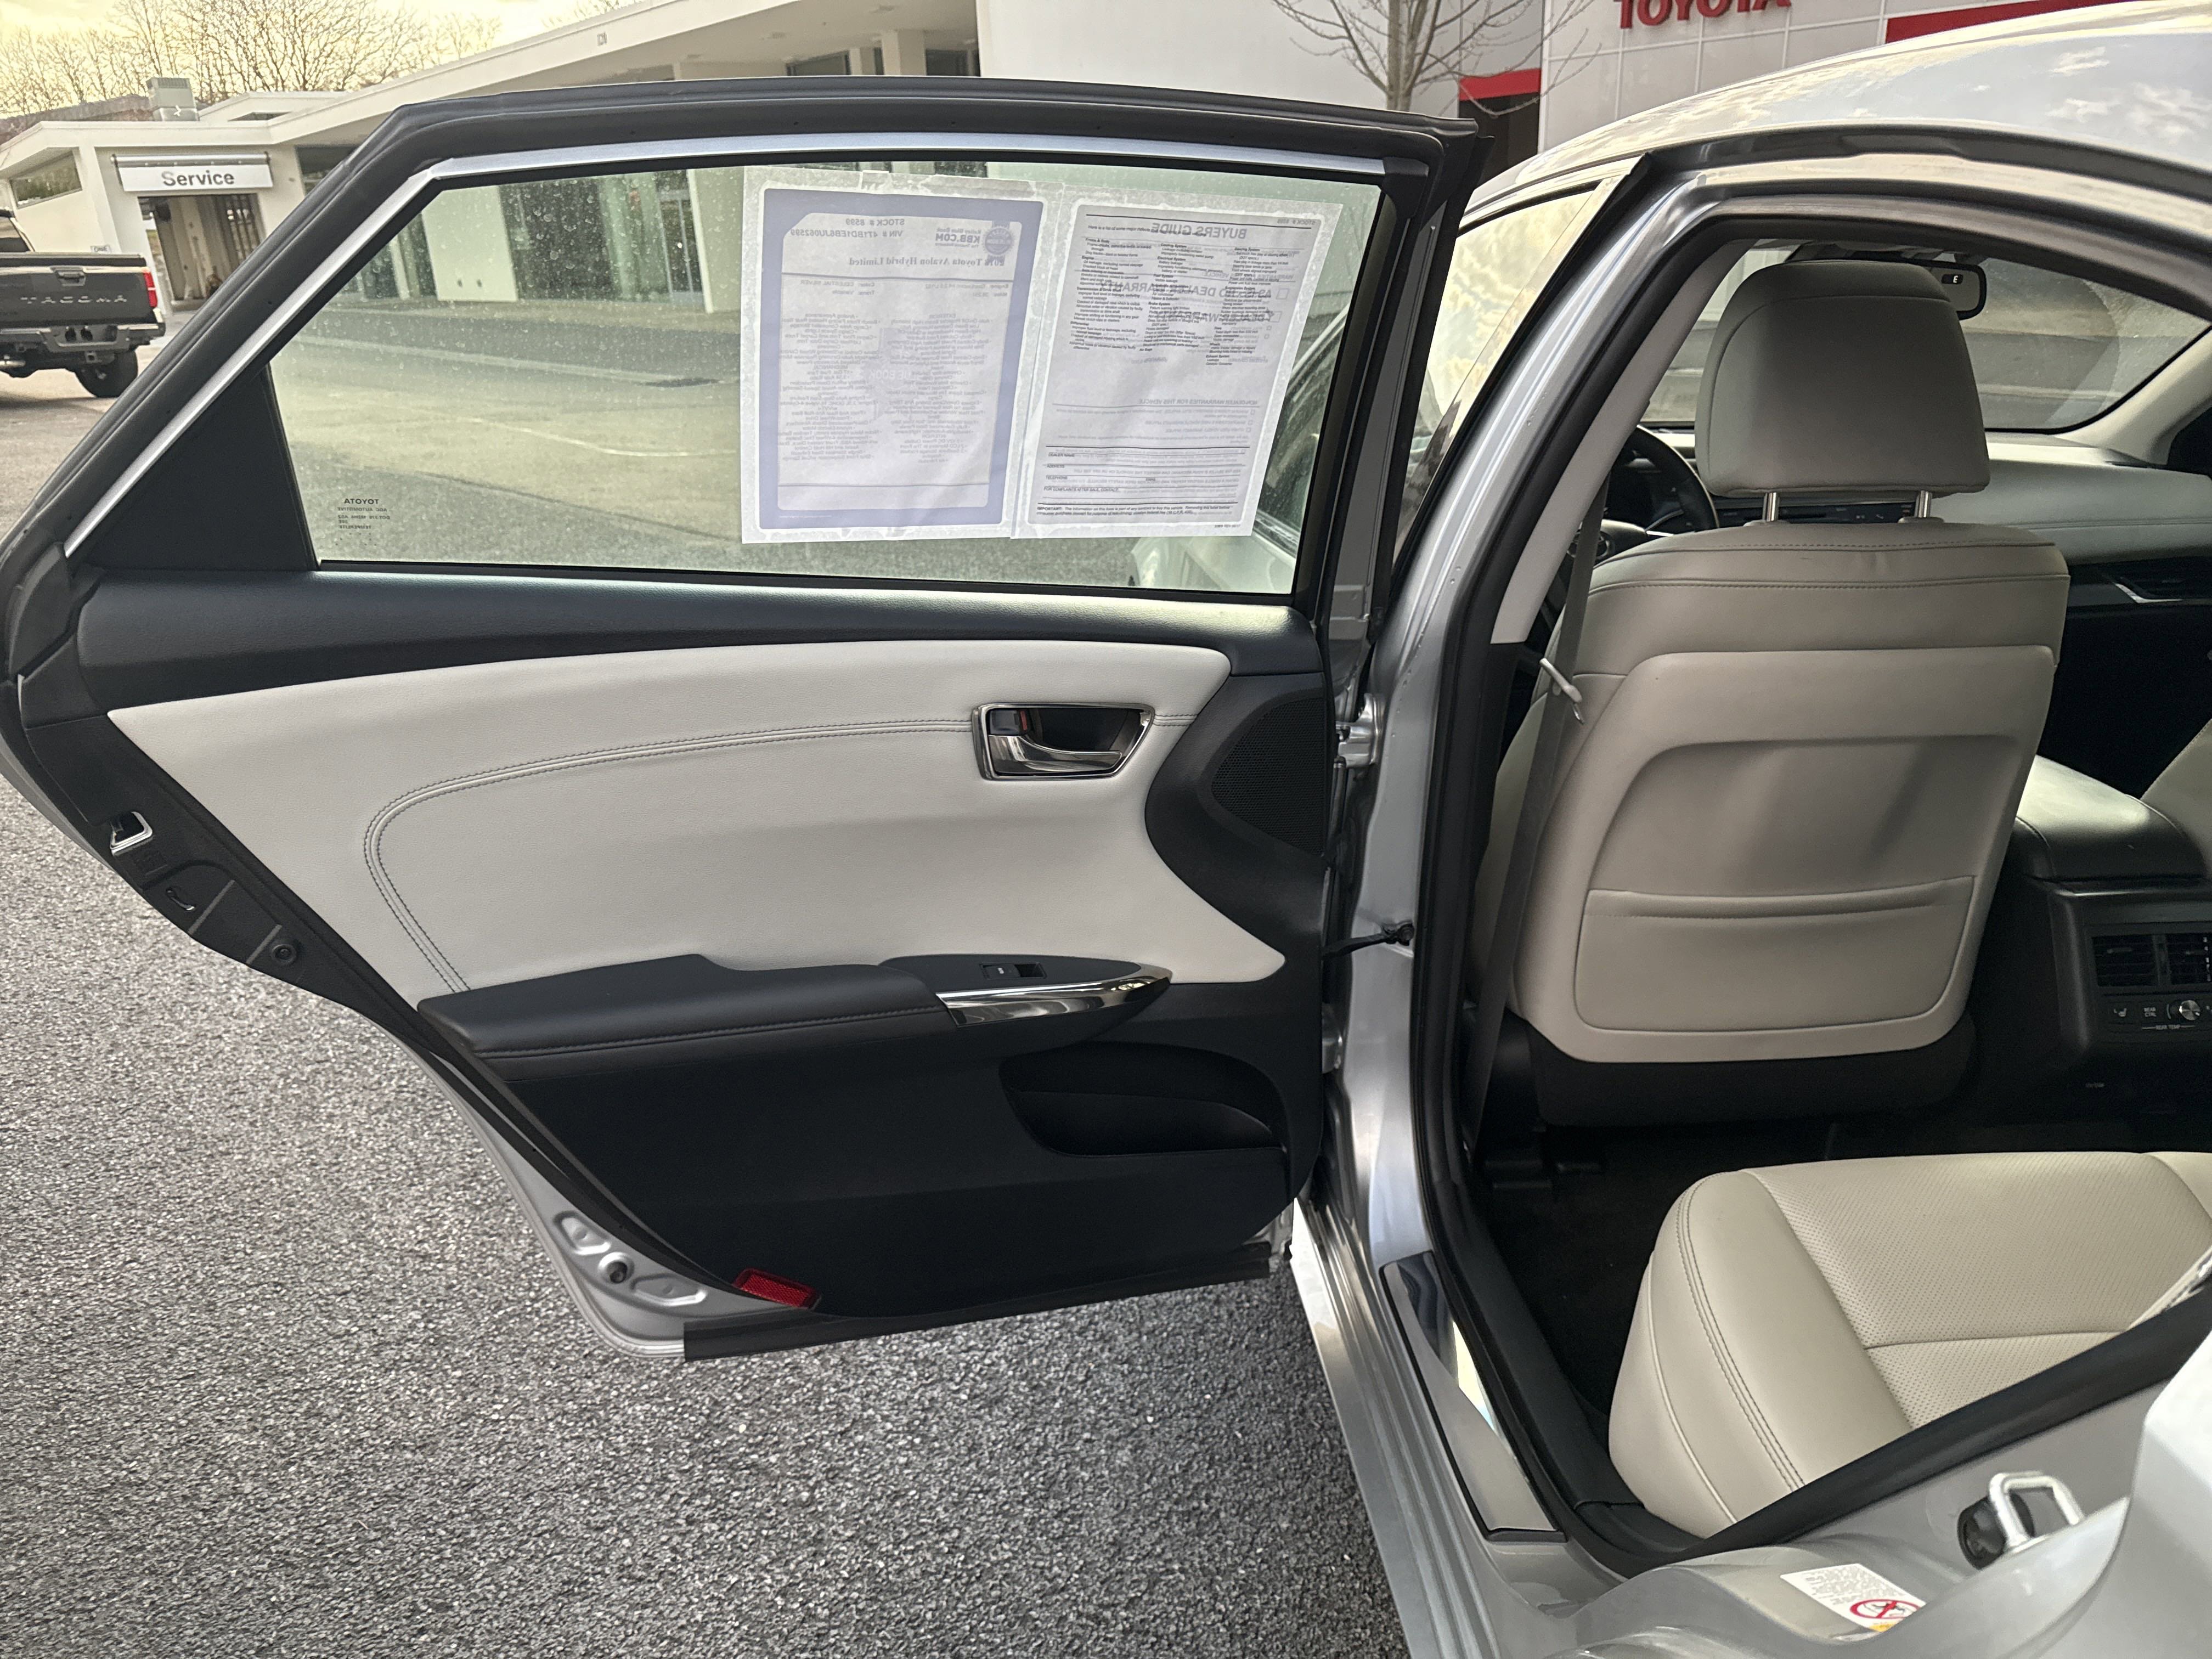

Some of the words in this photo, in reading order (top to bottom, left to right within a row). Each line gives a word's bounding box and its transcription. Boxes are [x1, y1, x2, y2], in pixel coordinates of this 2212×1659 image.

[1613, 0, 1791, 29] TOYO
[161, 170, 235, 187] Service
[20, 295, 127, 304] TACOMA
